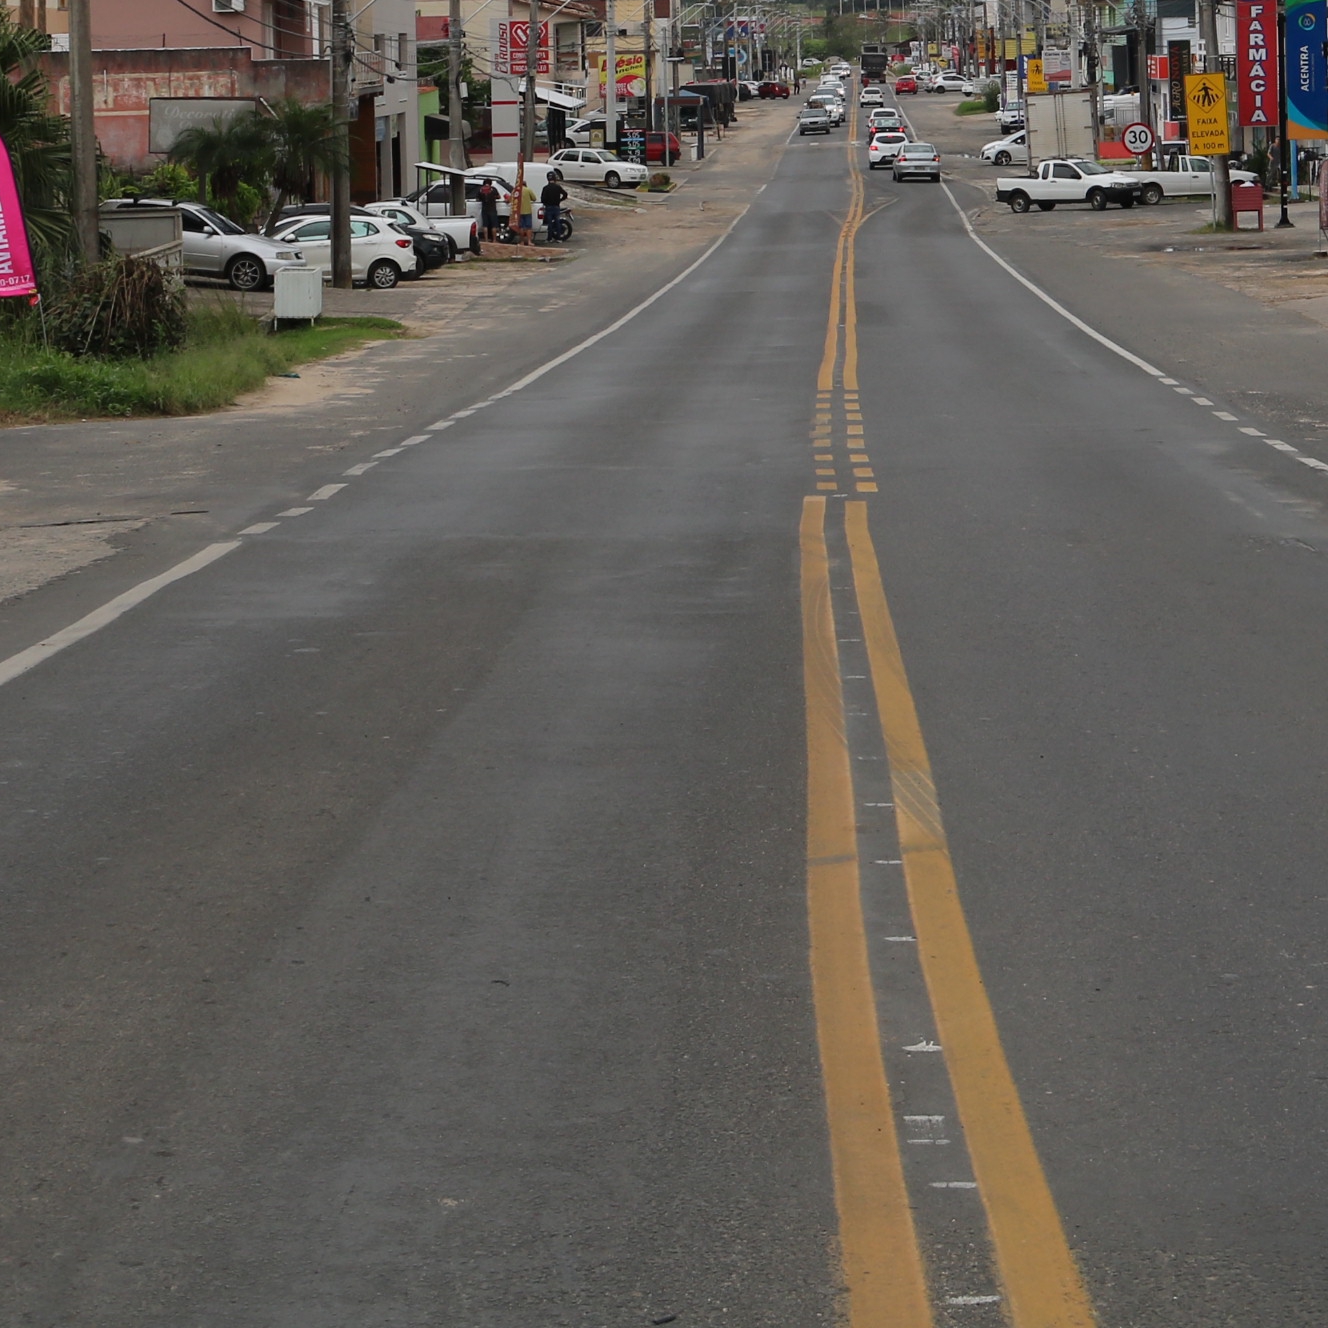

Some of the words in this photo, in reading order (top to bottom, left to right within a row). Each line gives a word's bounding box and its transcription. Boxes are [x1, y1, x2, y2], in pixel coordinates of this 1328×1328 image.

[1248, 5, 1268, 122] FARMÁCIA
[1300, 45, 1309, 92] ACENTRA
[1128, 130, 1149, 144] 30
[1192, 130, 1225, 138] ELEVADA
